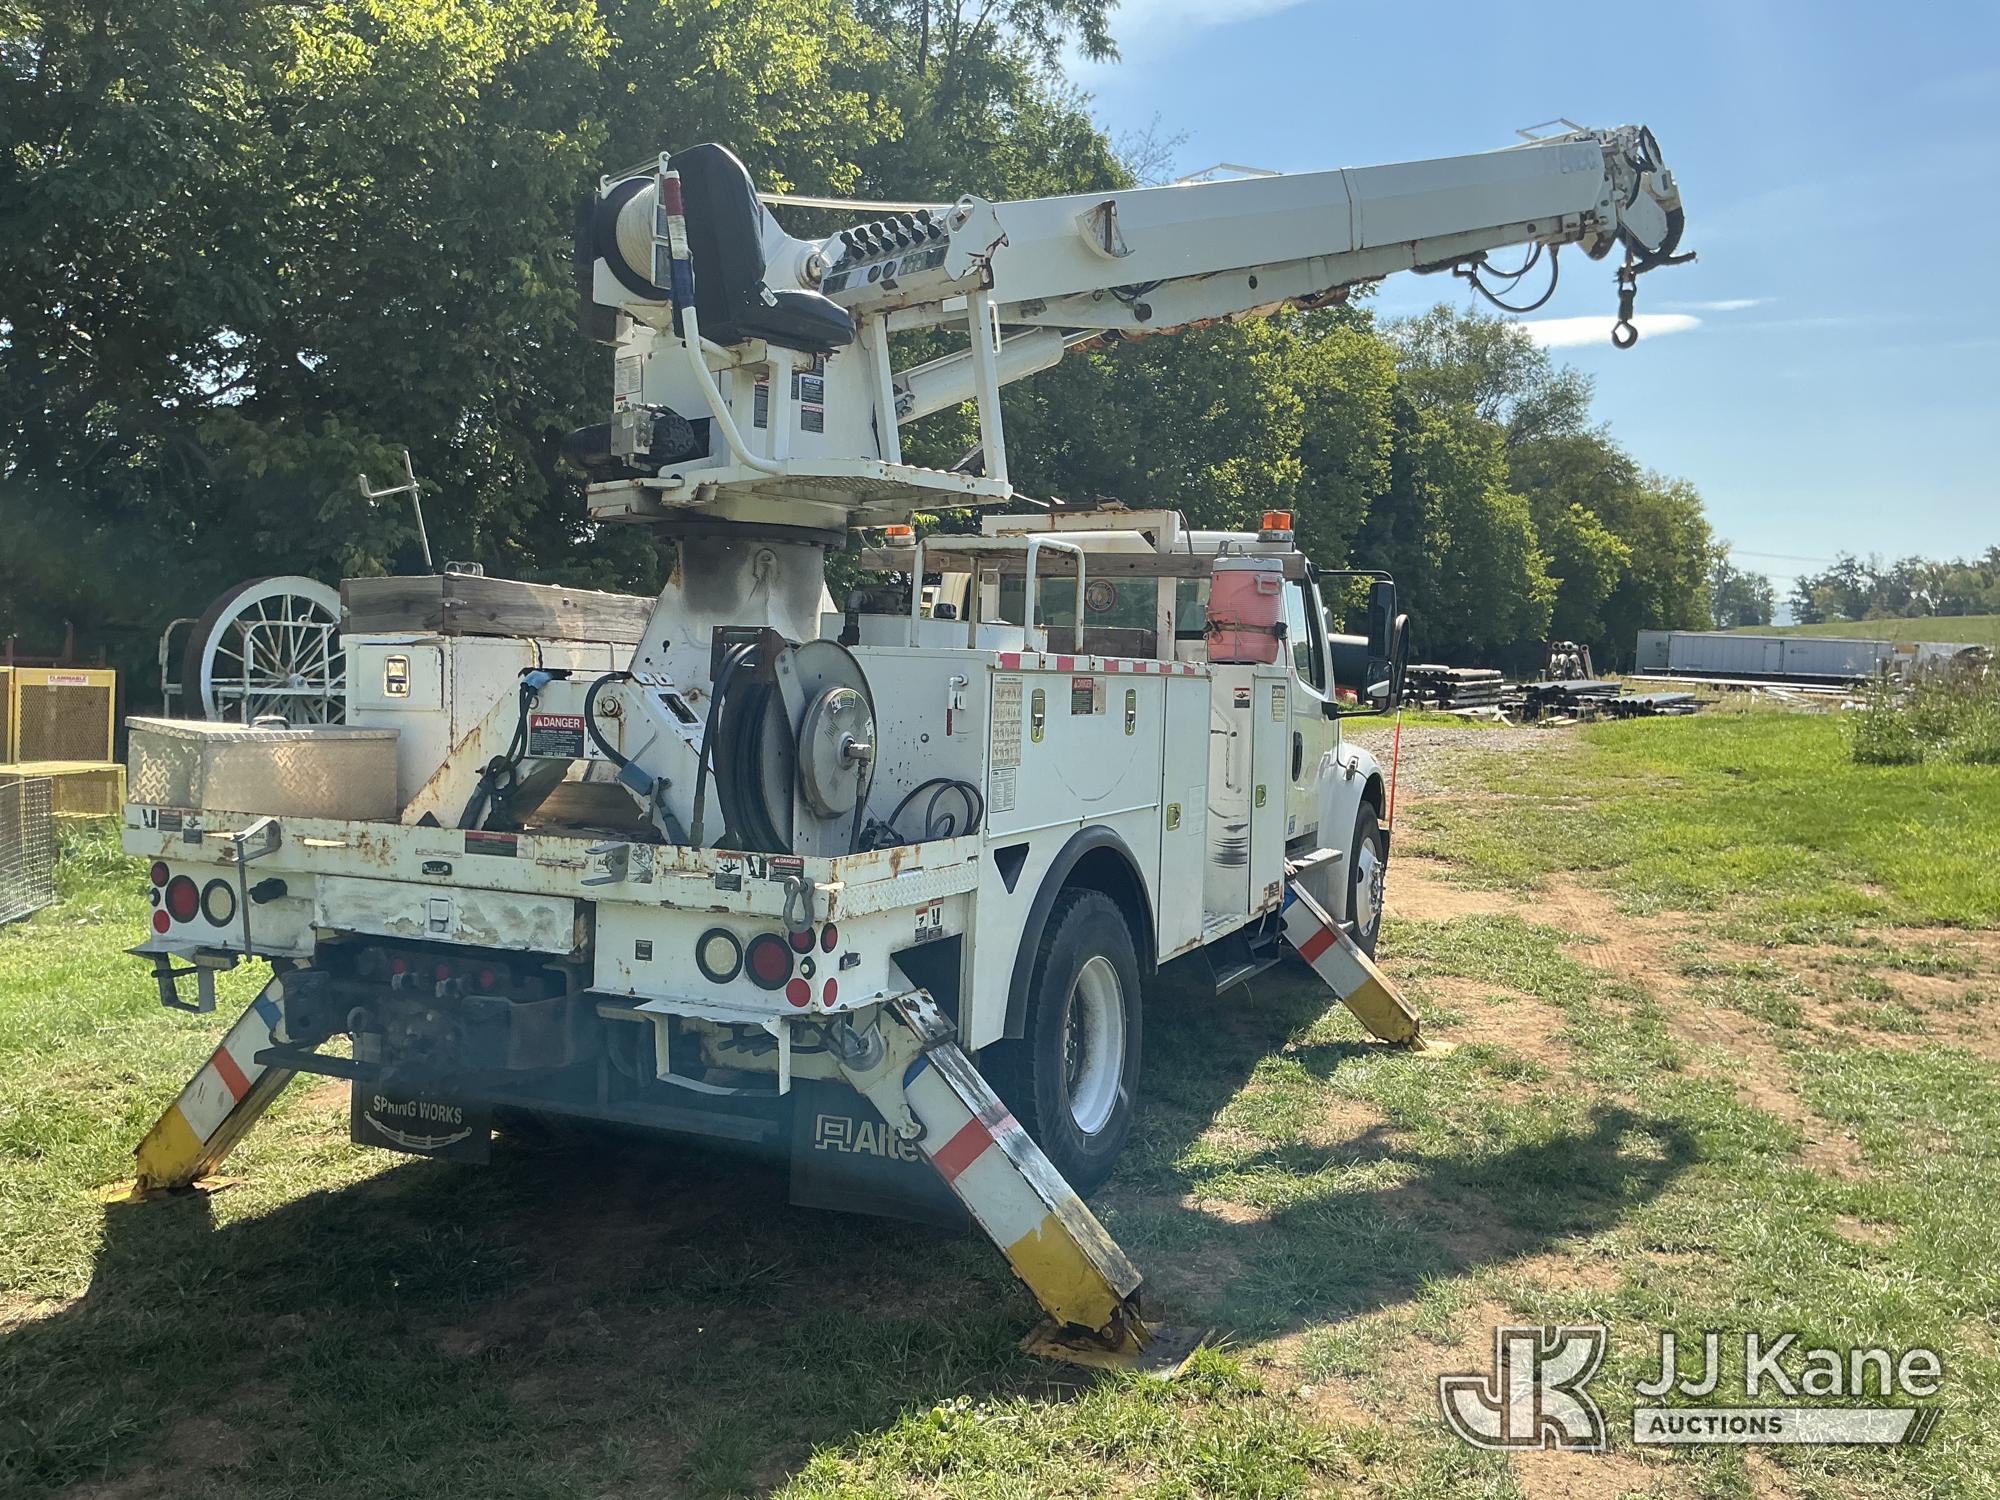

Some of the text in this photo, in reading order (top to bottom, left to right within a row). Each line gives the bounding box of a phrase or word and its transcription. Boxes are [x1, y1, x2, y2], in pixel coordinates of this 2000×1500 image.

[543, 717, 580, 728] DANGER
[373, 1095, 462, 1125] SPRING WORKS
[852, 1120, 923, 1163] Alte
